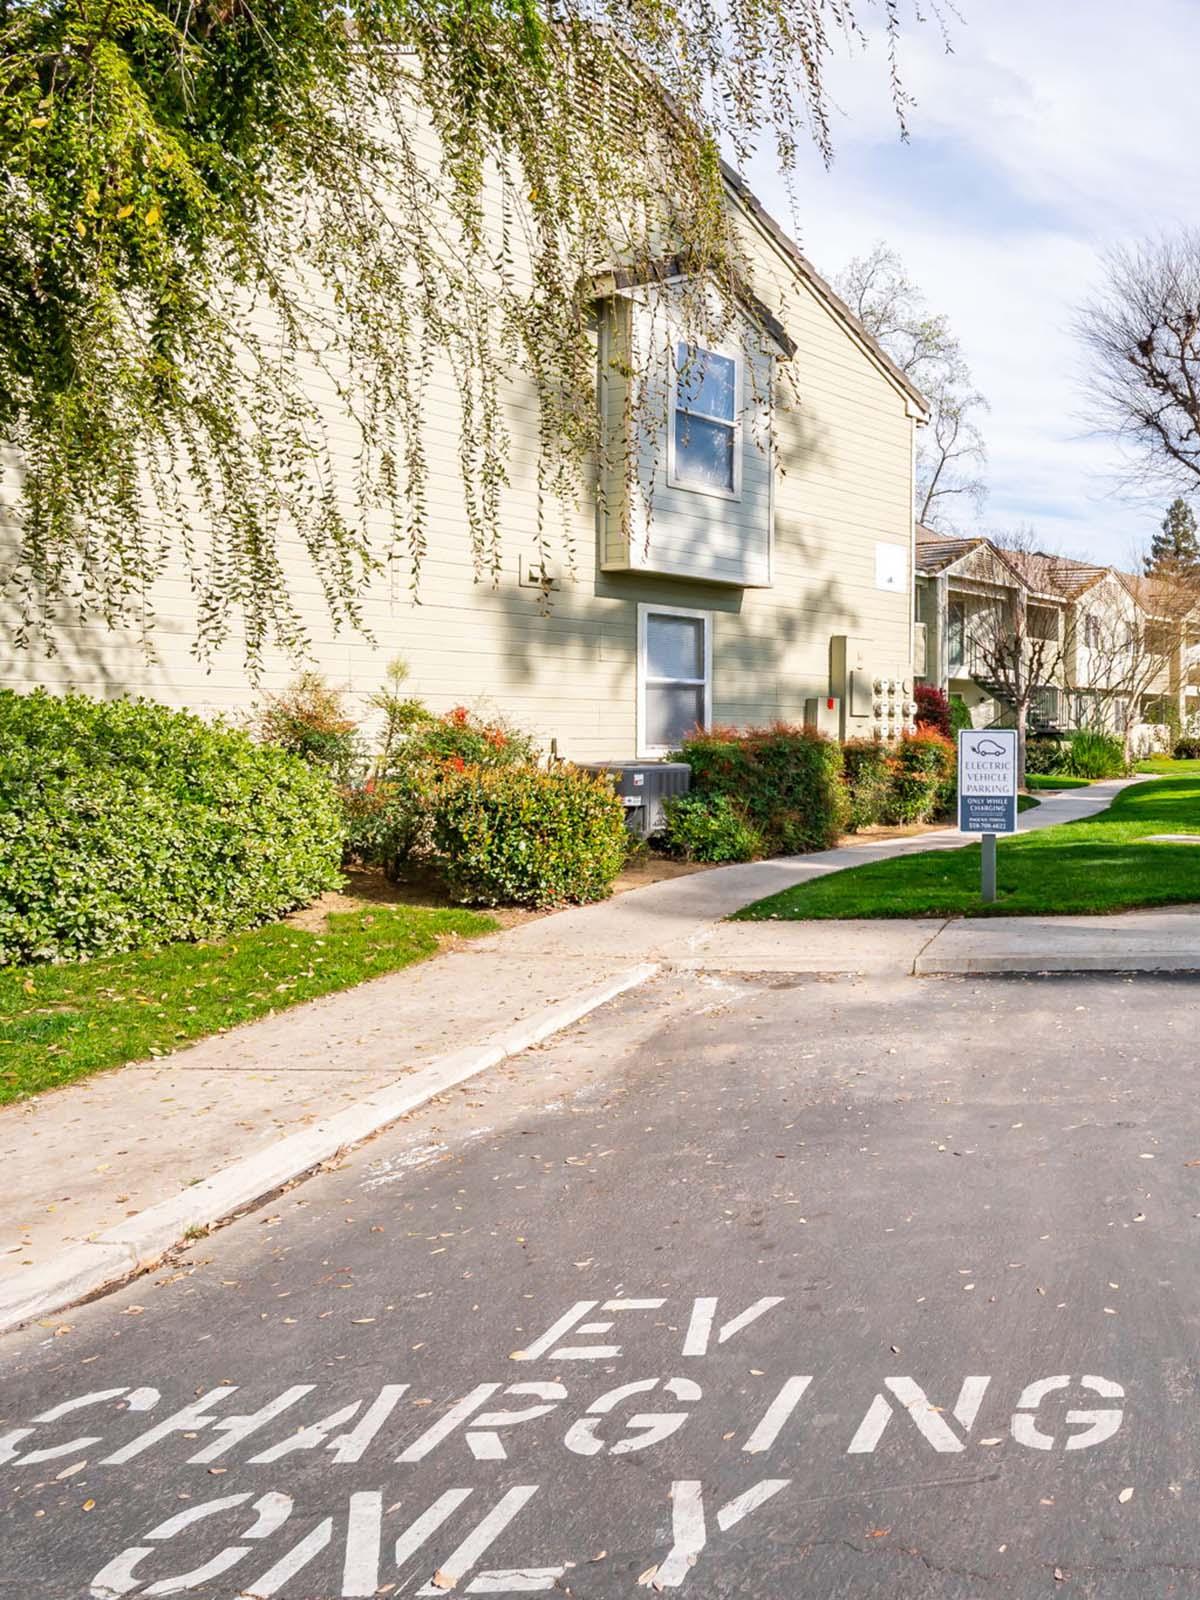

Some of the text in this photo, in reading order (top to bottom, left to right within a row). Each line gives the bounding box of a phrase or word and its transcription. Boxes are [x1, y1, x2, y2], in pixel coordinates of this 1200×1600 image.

[965, 761, 1010, 770] ELECTRIC
[967, 773, 1008, 782] VEHICLE
[966, 784, 1009, 793] PARKING
[520, 1296, 786, 1361] EV
[0, 1374, 1125, 1465] CHARGING
[90, 1478, 792, 1599] ONLY
